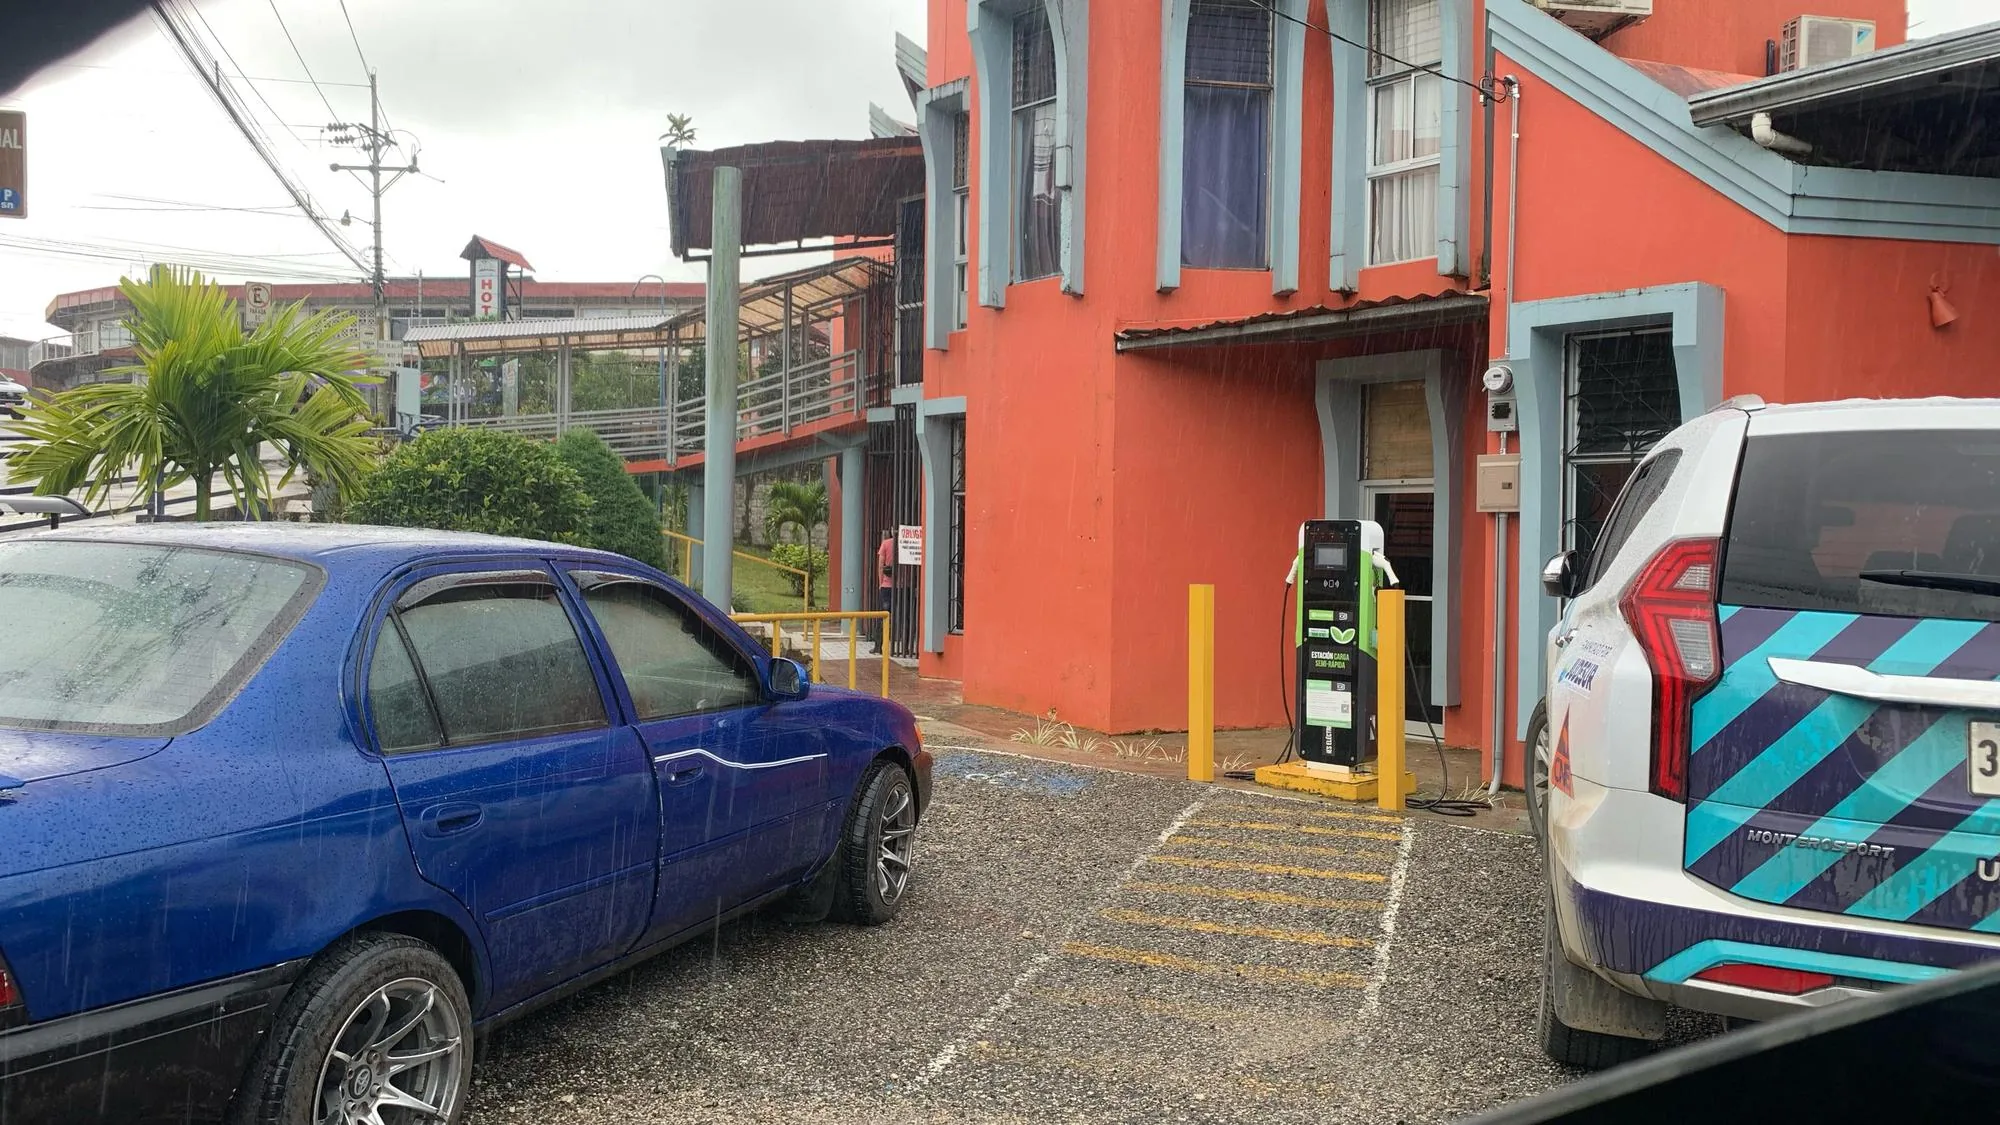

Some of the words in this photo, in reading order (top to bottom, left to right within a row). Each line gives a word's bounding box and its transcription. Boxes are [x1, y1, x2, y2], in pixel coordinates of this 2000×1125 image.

[0, 128, 22, 149] AL
[4, 189, 12, 201] P
[1311, 651, 1333, 659] ESTACIÓN
[1977, 739, 1999, 777] 3
